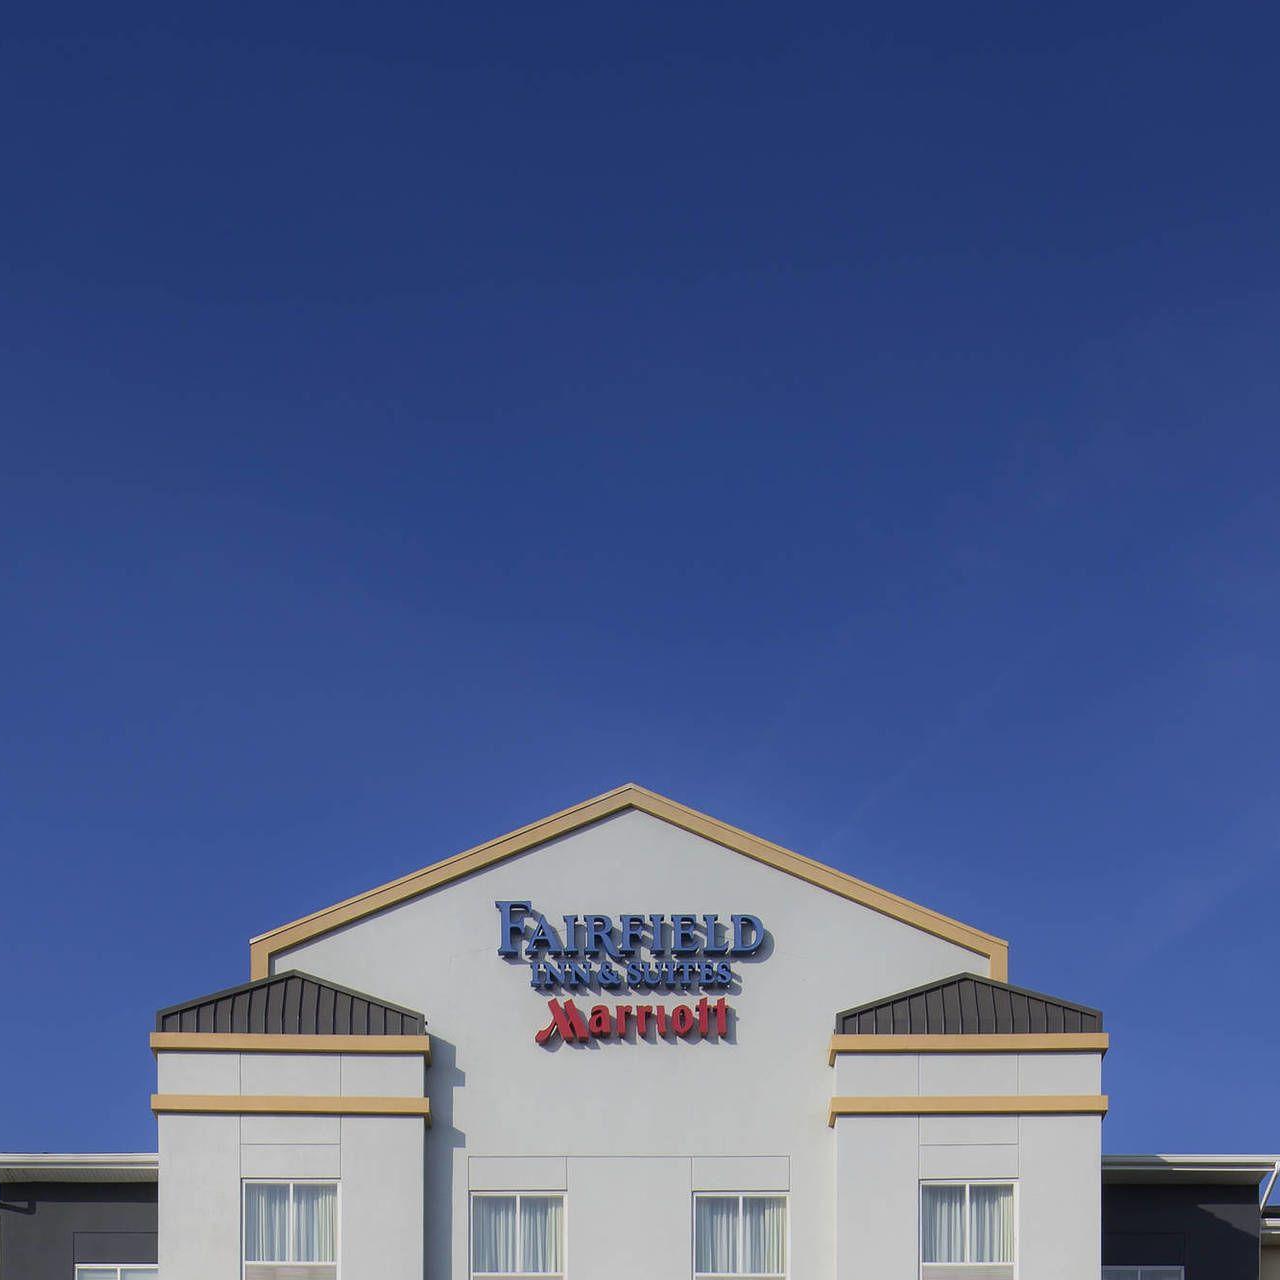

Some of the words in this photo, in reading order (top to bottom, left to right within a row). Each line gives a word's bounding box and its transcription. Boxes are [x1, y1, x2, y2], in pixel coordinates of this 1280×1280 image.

[494, 900, 765, 957] FAIRFIELD
[530, 960, 592, 988] INN
[597, 961, 622, 986] &
[627, 960, 733, 987] SUITES
[534, 997, 728, 1045] Marriott
